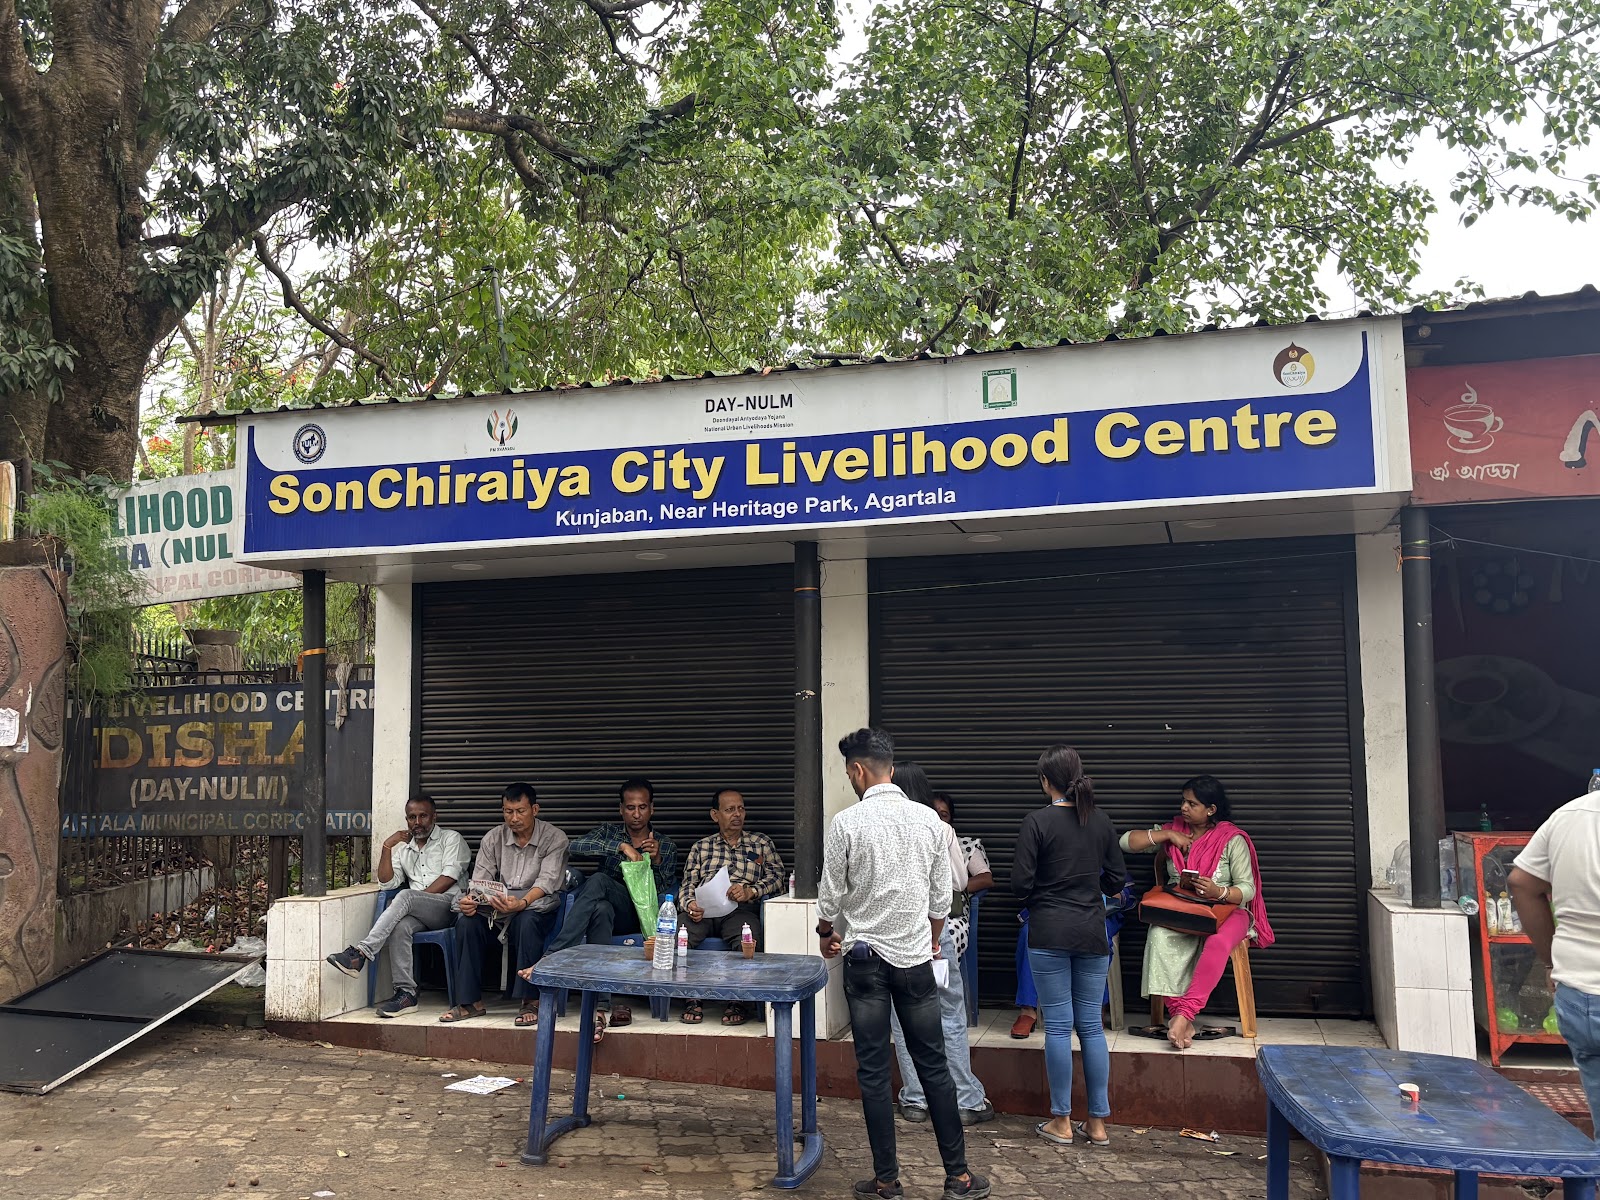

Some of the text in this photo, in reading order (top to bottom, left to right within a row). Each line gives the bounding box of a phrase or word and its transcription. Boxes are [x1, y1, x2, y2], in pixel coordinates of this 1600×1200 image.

[705, 393, 793, 414] DAY-NULM
[268, 403, 1337, 515] SonChiraiya City Livelihood Centre
[556, 487, 956, 529] Kunjaban, Near Heritage Park, Agartala
[130, 775, 289, 809] (DAY-NULM)
[141, 812, 238, 831] MUNICIPAL
